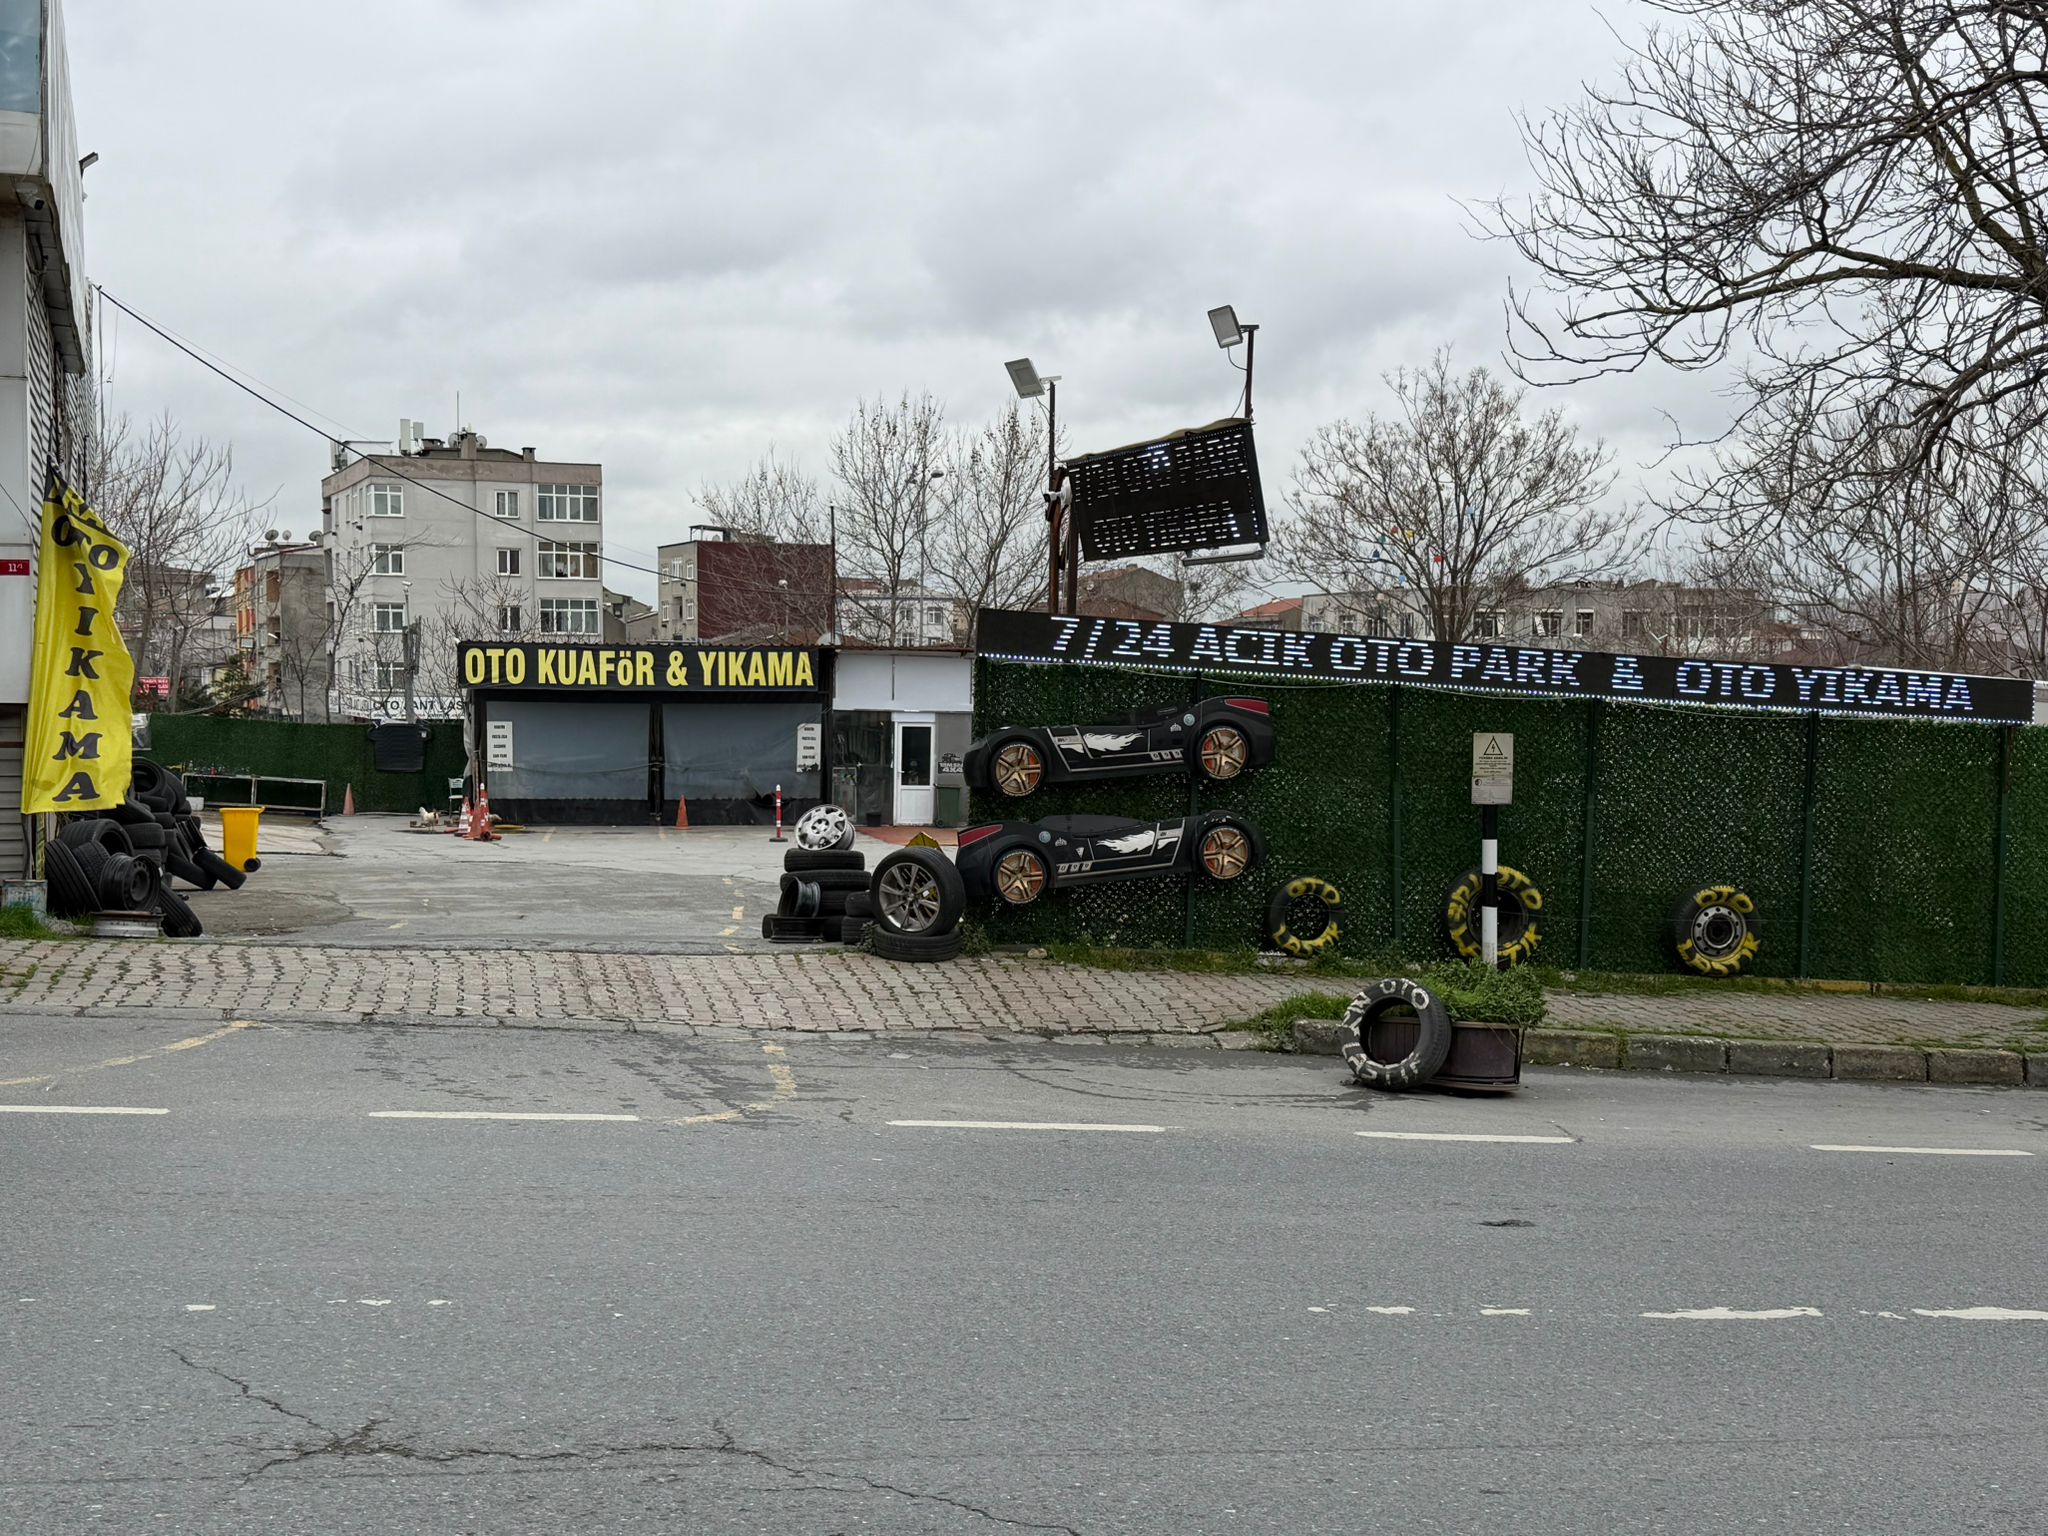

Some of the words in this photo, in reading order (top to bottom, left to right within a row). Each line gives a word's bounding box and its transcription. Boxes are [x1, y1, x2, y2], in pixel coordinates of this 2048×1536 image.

[1122, 450, 1171, 493] OTO
[1175, 434, 1248, 484] PARK
[52, 515, 120, 571] OTO
[1093, 514, 1139, 553] OTO
[464, 648, 526, 685] OTO
[665, 650, 689, 688] &
[697, 650, 815, 688] YIKAMA
[1051, 616, 1175, 658] 7/24
[1330, 636, 1435, 676] OTO
[1451, 645, 1583, 686] PARK
[1611, 656, 1644, 691] &
[1676, 661, 1776, 699] OTO
[1791, 668, 1974, 711] YIKAMA
[1287, 877, 1341, 905] OTO
[1695, 885, 1754, 914] OTO
[1380, 978, 1430, 1010] OTO
